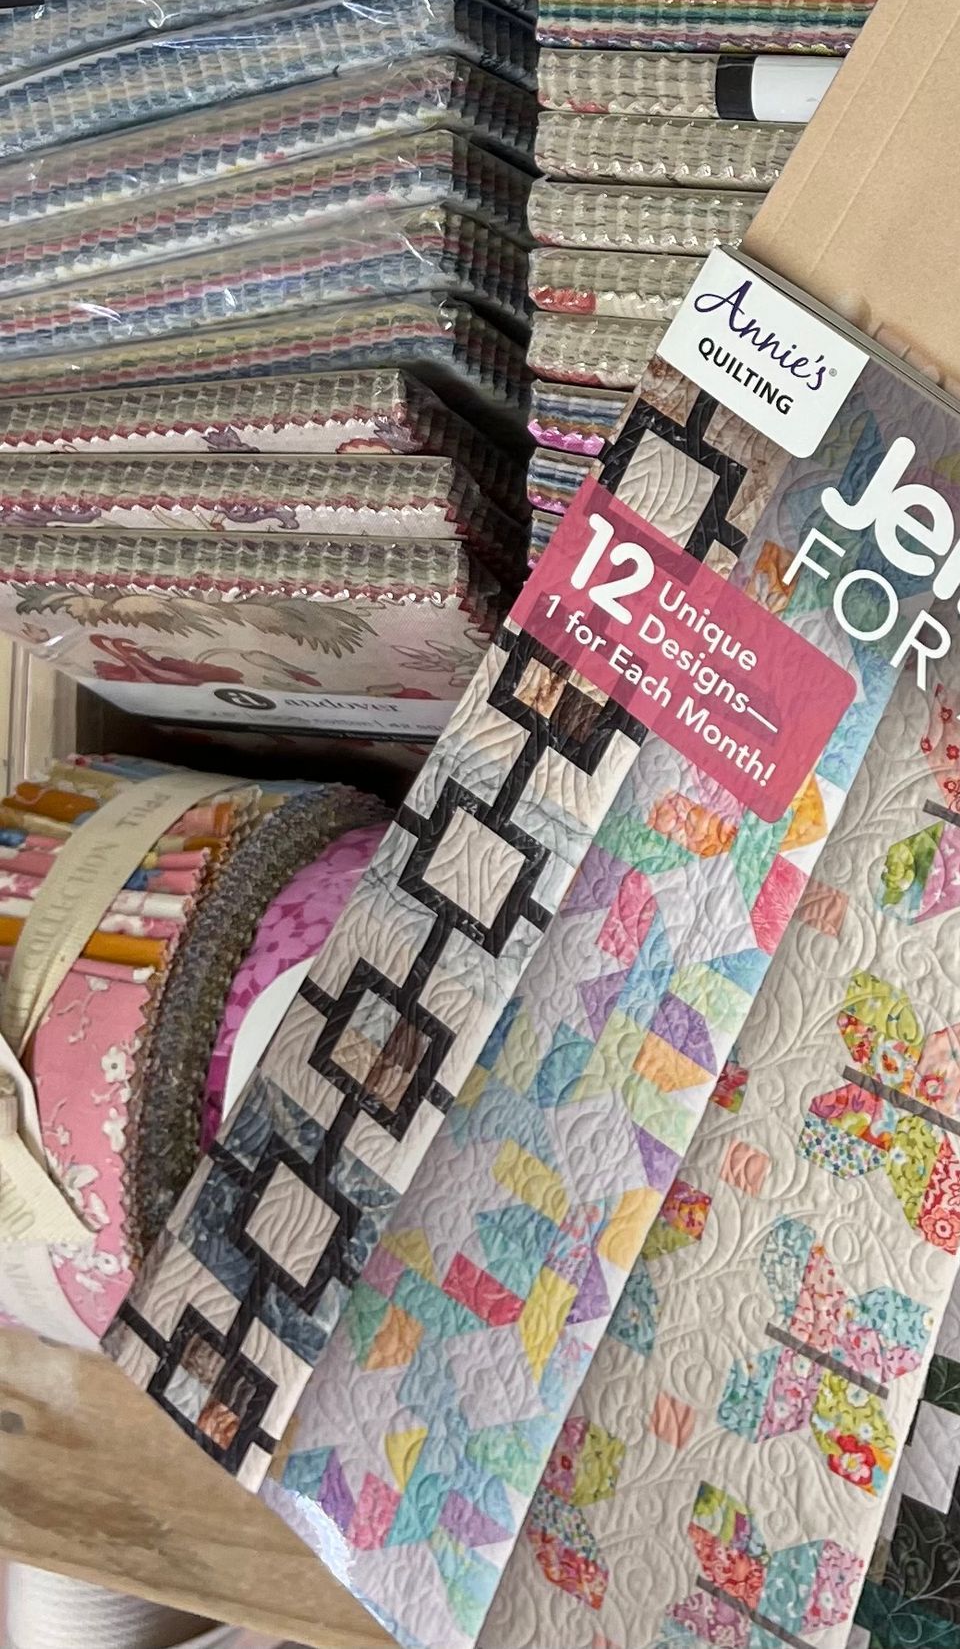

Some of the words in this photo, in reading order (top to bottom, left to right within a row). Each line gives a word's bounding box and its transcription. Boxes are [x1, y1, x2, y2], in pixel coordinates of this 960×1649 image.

[694, 279, 827, 391] Annie's
[698, 336, 795, 416] QUILTING
[570, 512, 656, 626] 12
[781, 527, 953, 692] FOR
[658, 580, 759, 672] Unique
[545, 594, 562, 619] 1
[564, 610, 608, 654] for
[607, 645, 674, 709] Each
[675, 695, 778, 788] Month!
